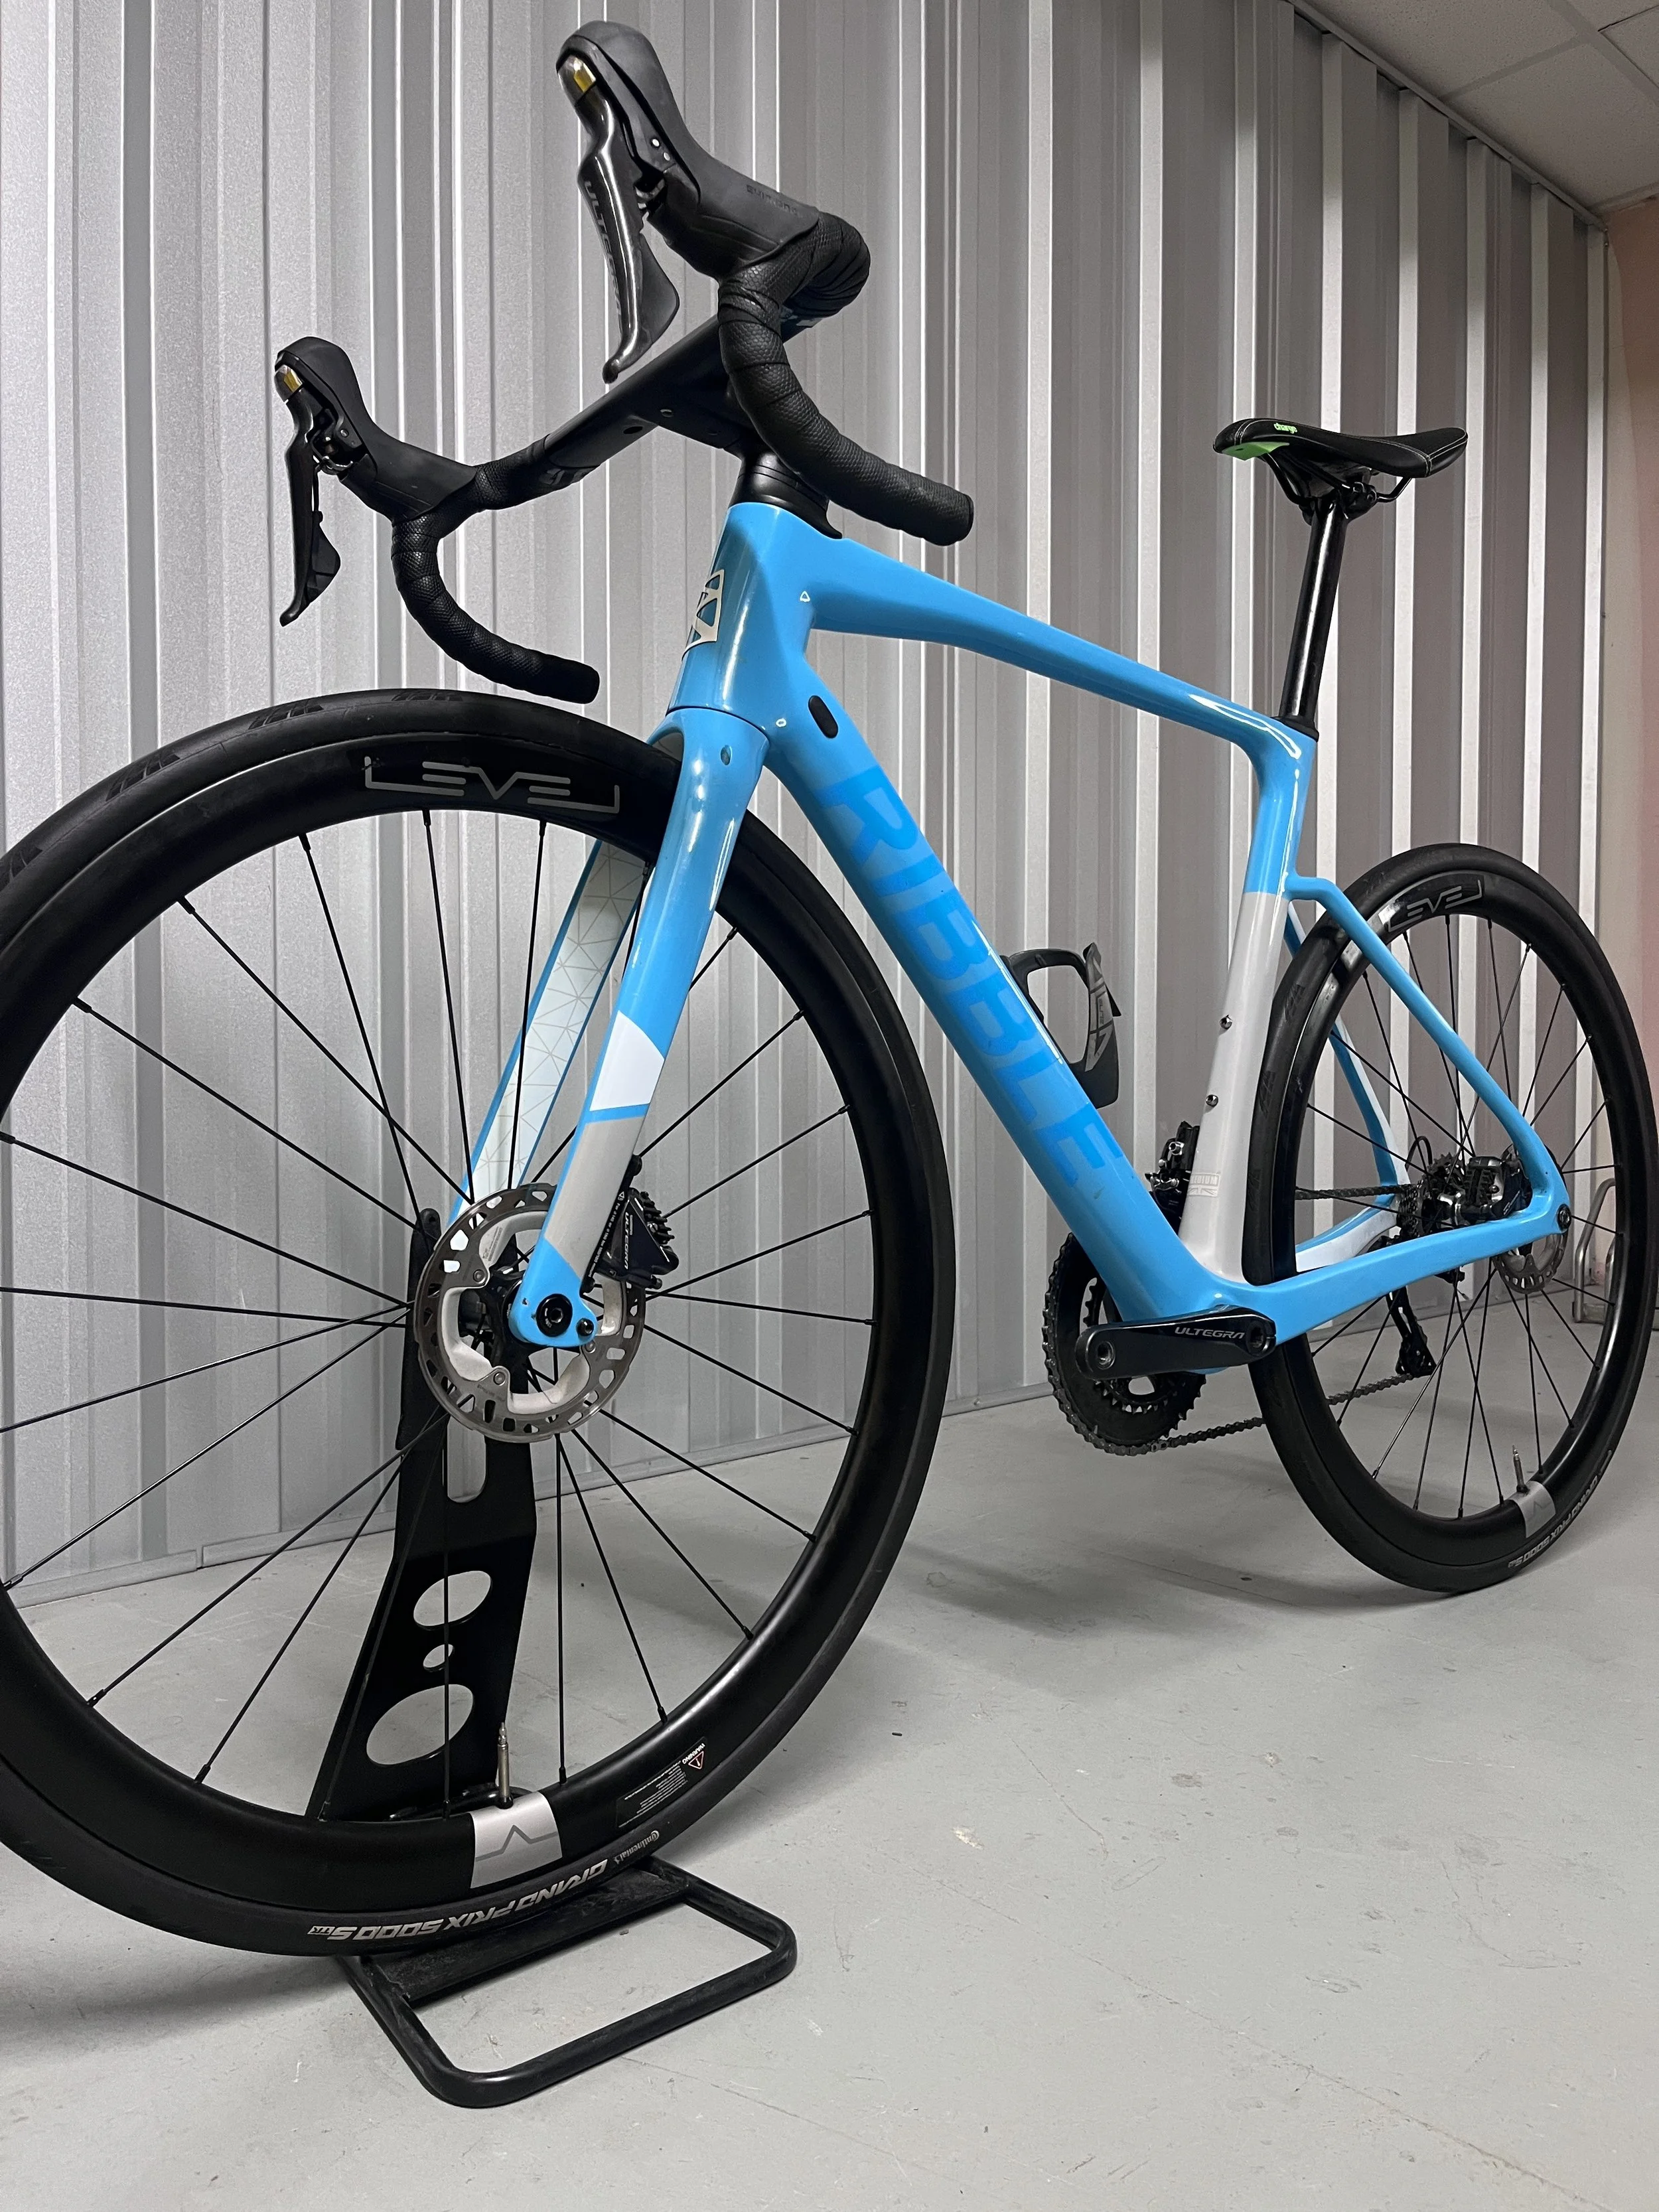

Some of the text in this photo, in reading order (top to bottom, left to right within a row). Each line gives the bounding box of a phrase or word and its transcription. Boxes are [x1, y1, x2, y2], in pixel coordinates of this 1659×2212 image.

[583, 181, 622, 316] ULTEGRA
[817, 765, 1124, 1186] RIBBLE
[1175, 1327, 1245, 1340] ULTEGRA
[682, 1743, 705, 1764] WARNING
[515, 1859, 608, 1911] GRAND
[443, 1907, 516, 1931] PRIX
